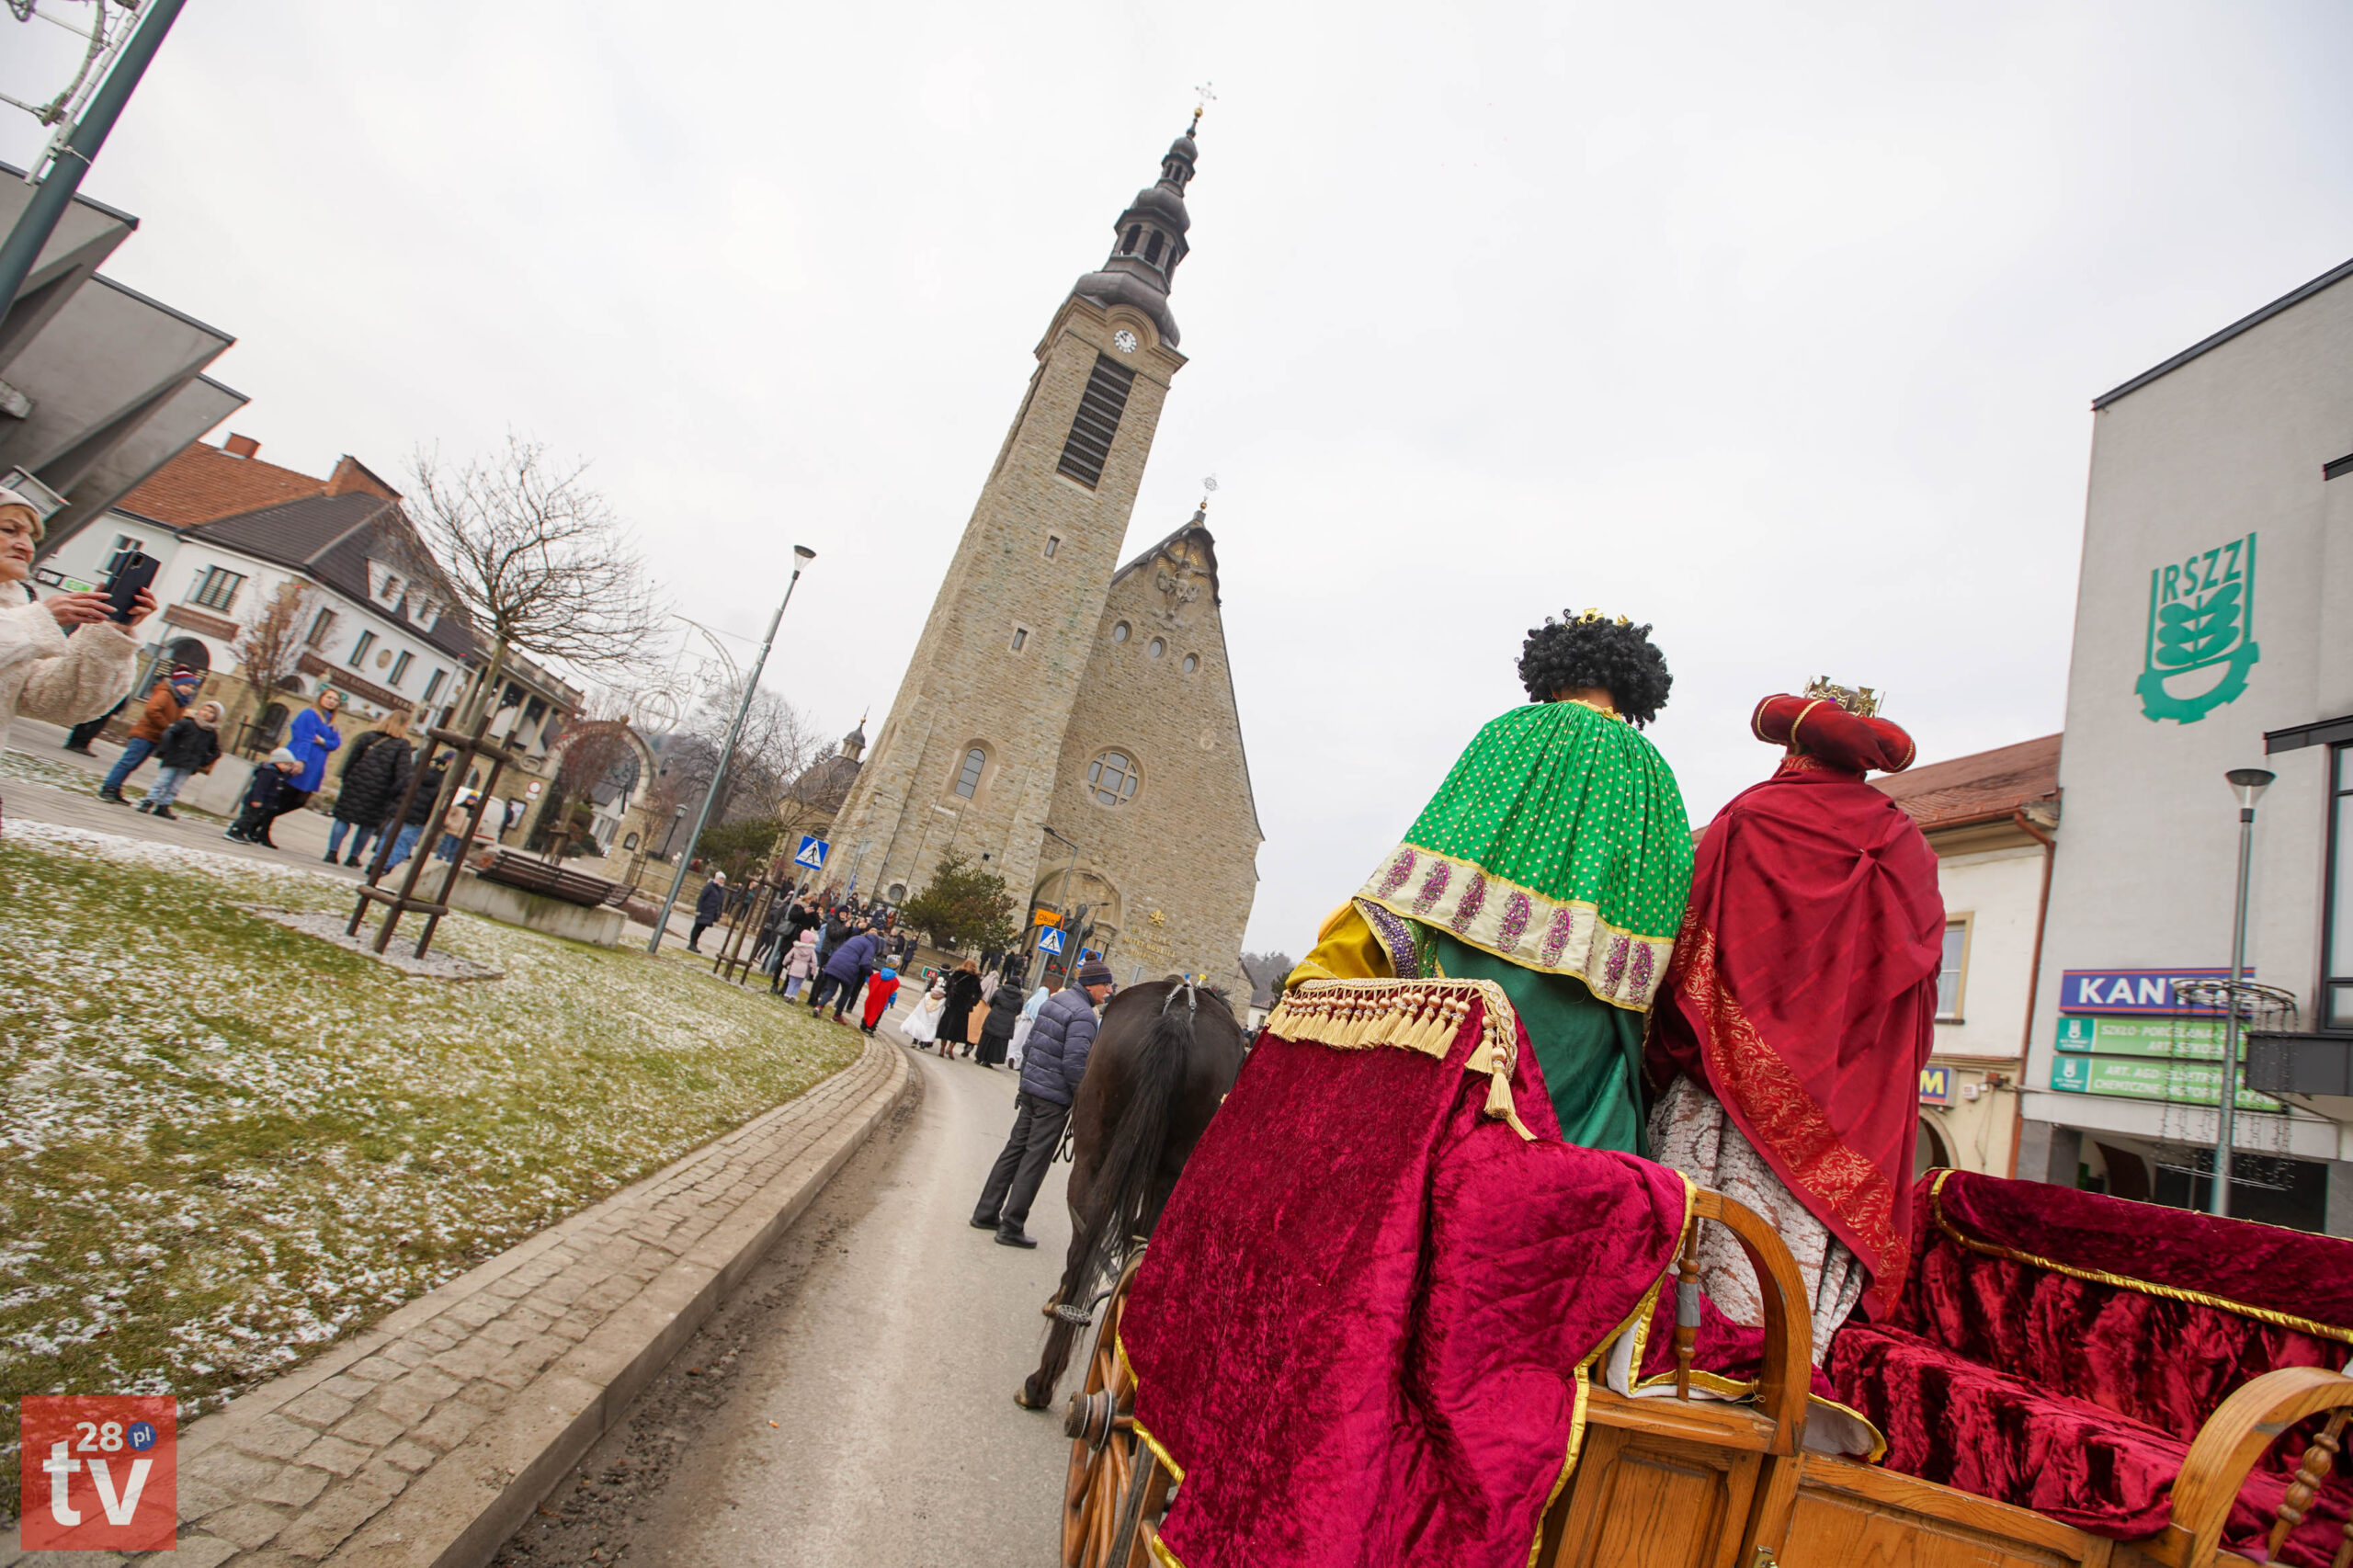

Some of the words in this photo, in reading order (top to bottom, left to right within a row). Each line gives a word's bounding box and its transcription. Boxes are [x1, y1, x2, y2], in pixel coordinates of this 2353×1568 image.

[2162, 539, 2244, 604] RSZZ
[2078, 976, 2255, 1007] KANT
[2094, 1078, 2161, 1095] CHEMICZNE
